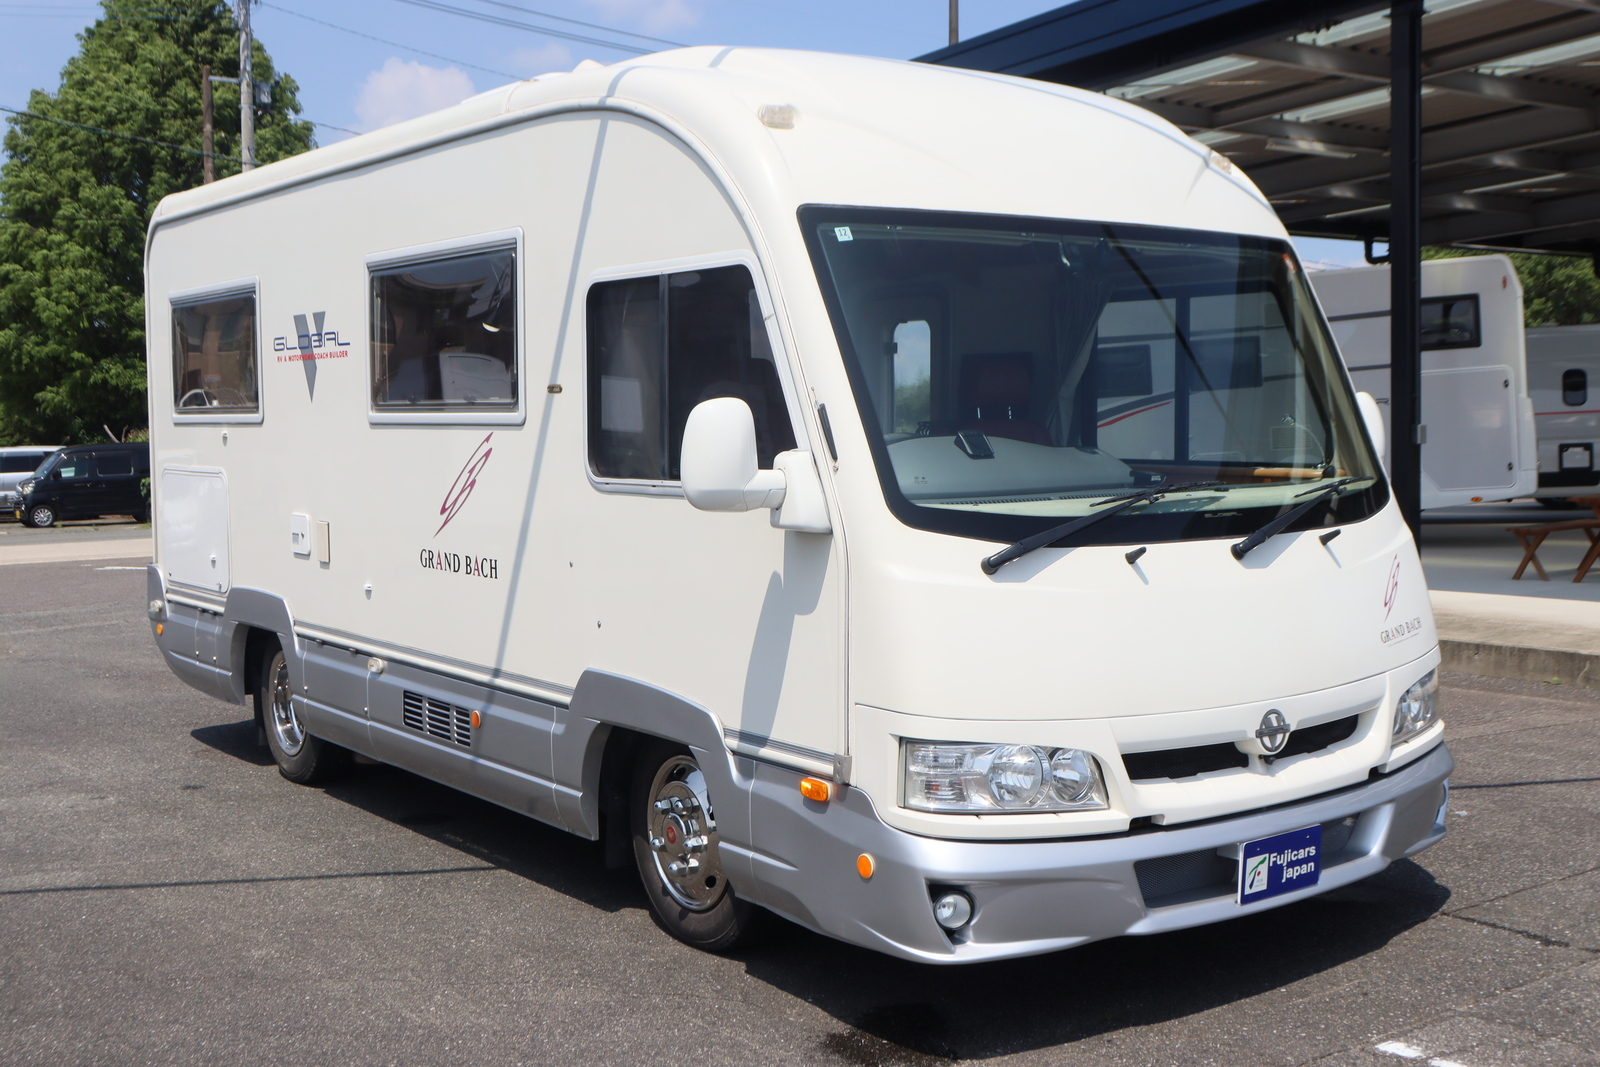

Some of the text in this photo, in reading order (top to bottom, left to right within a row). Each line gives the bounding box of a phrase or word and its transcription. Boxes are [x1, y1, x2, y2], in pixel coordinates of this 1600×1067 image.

[838, 228, 848, 236] 12
[273, 331, 351, 352] GLOBAL
[314, 352, 329, 360] COACH
[329, 350, 348, 358] BUILDER
[420, 548, 498, 579] GRAND BACH
[1380, 616, 1422, 643] GRAND BACH
[1269, 845, 1316, 867] Fujicars
[1281, 861, 1315, 883] japan
